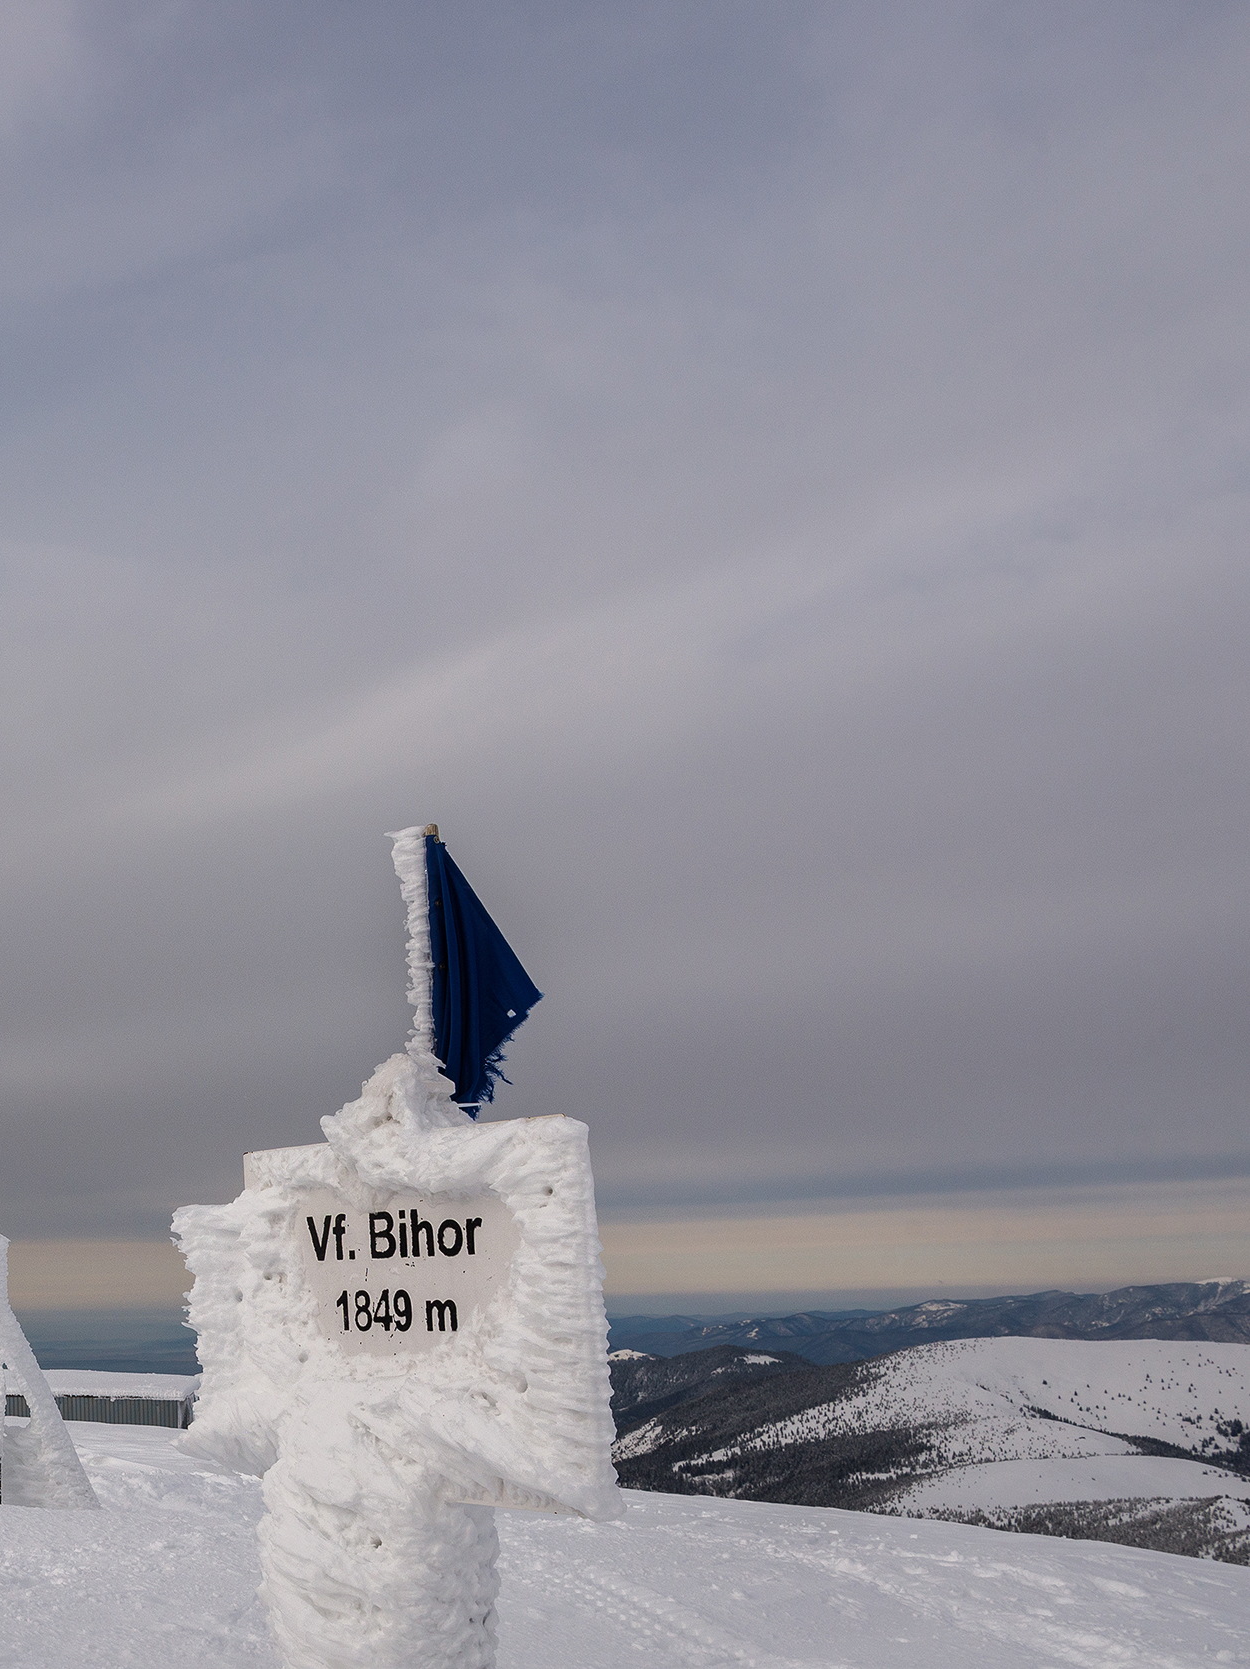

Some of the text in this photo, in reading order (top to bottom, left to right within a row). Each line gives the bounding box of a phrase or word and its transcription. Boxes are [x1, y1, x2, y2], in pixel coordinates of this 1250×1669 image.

[306, 1208, 483, 1262] Vf. Bihor
[336, 1288, 459, 1333] 1849 m
